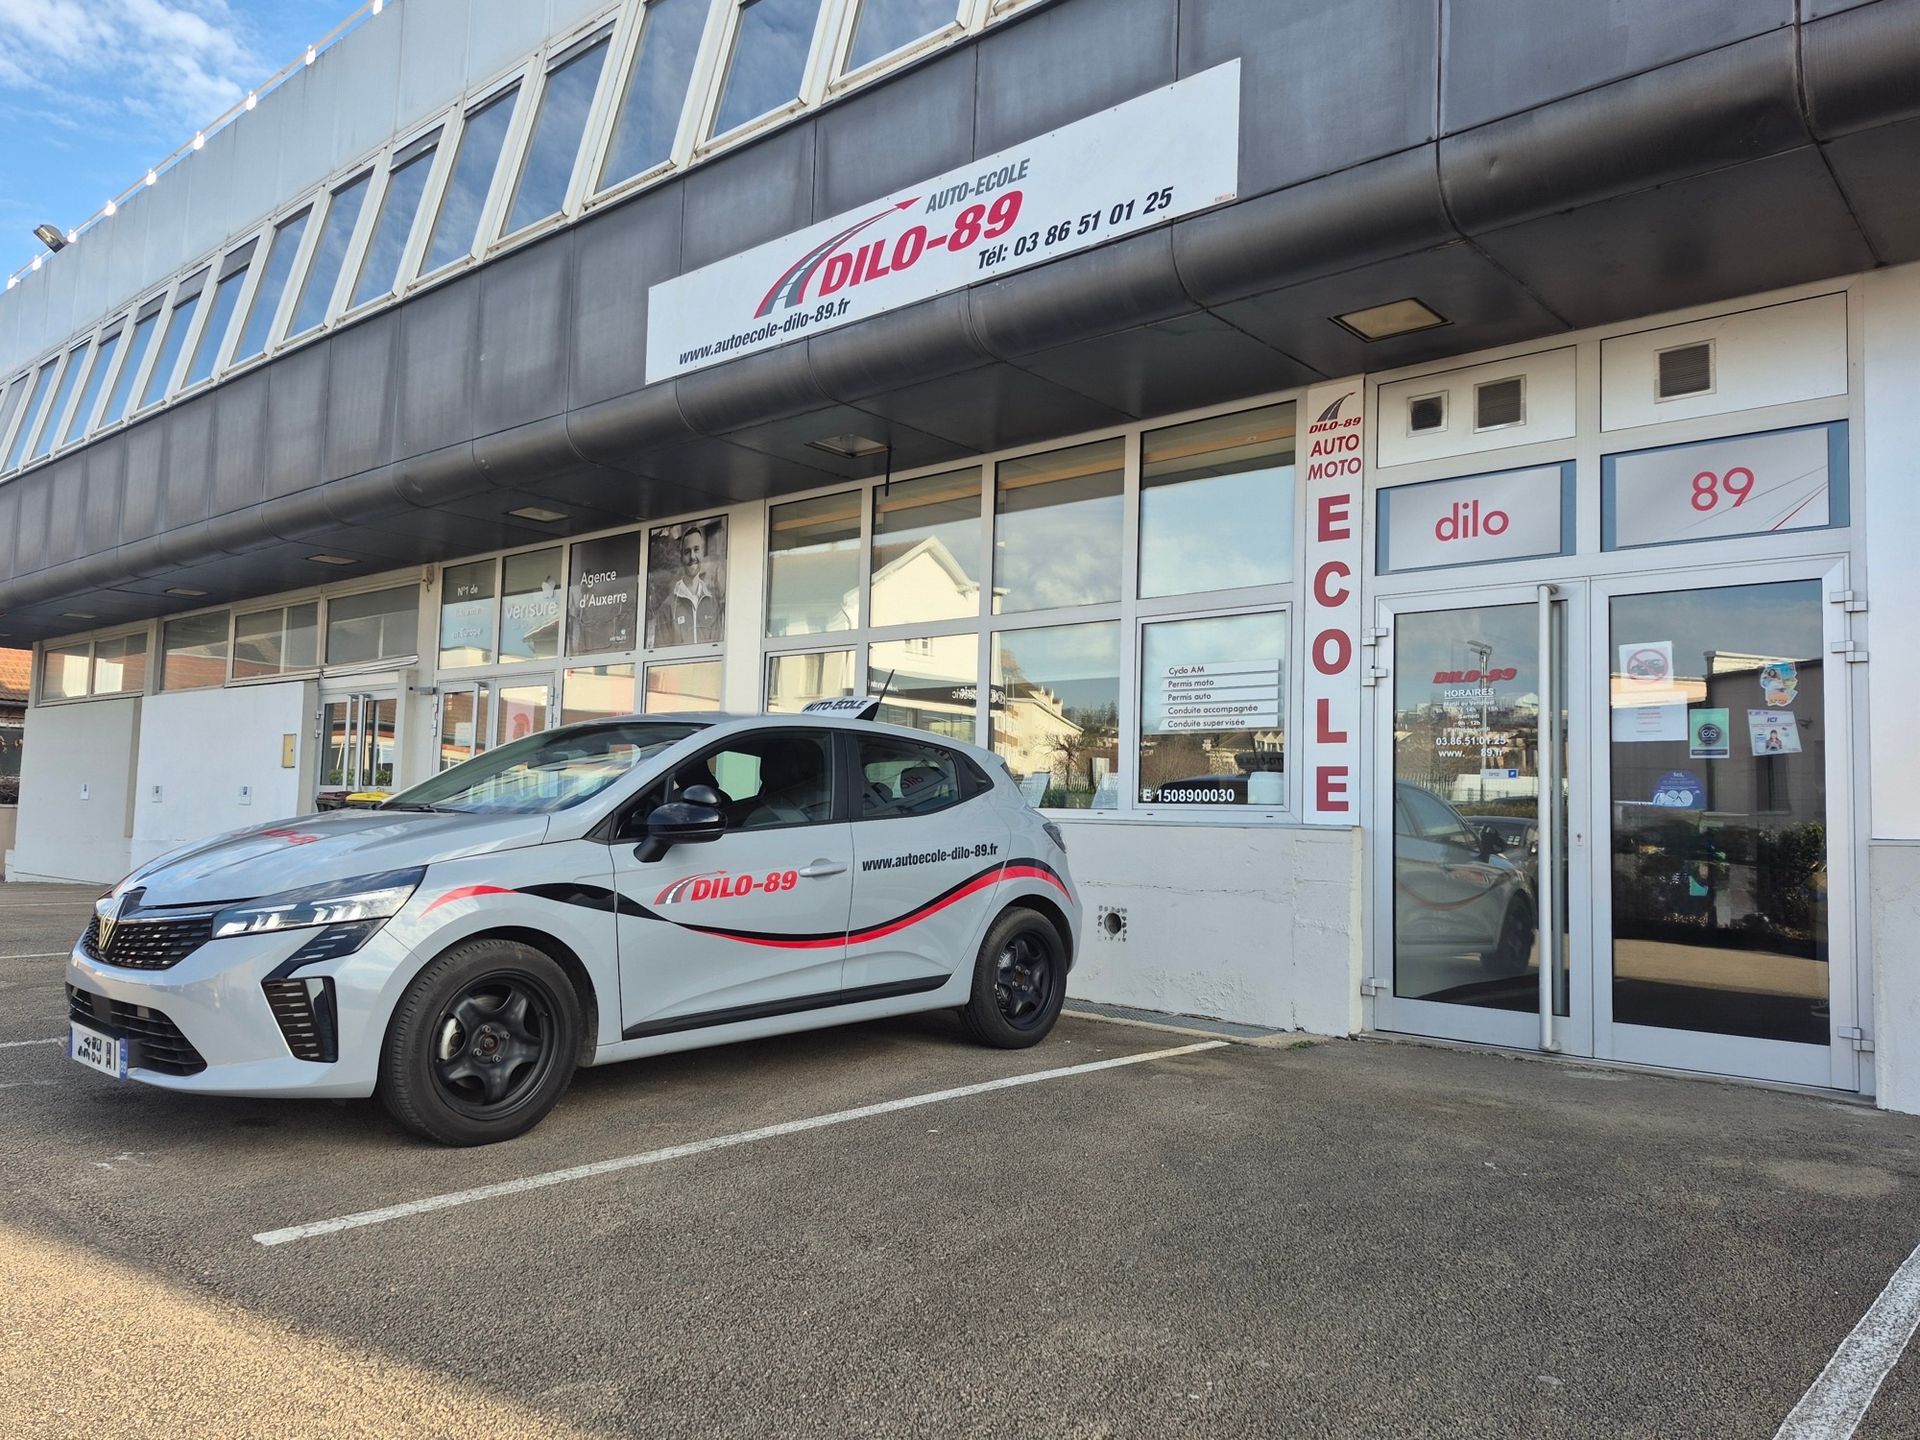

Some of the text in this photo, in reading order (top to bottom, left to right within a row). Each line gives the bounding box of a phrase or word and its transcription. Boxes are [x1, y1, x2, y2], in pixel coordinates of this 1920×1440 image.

[925, 158, 1030, 215] AUTO-ECOLE
[978, 186, 1174, 270] Tél: 03 86 51 01 25
[818, 190, 1024, 297] DILO-89
[678, 297, 851, 366] www.autoecole-dilo-89.fr
[1309, 416, 1362, 434] DILO-89
[1310, 434, 1360, 458] AUTO
[1307, 457, 1362, 482] MOTO
[1690, 466, 1756, 512] 89
[1435, 500, 1510, 542] dilo
[580, 570, 617, 588] Agence
[579, 592, 628, 609] d'Auxerre
[1312, 493, 1352, 812] ECOLE
[1168, 665, 1205, 677] Cyclo AM
[1168, 679, 1215, 688] Permis moto
[1444, 688, 1495, 697] HORAIRES
[1167, 692, 1212, 702] Permis auto
[1167, 704, 1259, 715] Conduite accompagnée
[1167, 719, 1246, 730] Conduite supervisée
[1156, 788, 1235, 802] 1508900030
[862, 844, 999, 872] www.autoecole-dilo-89.fr
[691, 870, 798, 902] DILO-89
